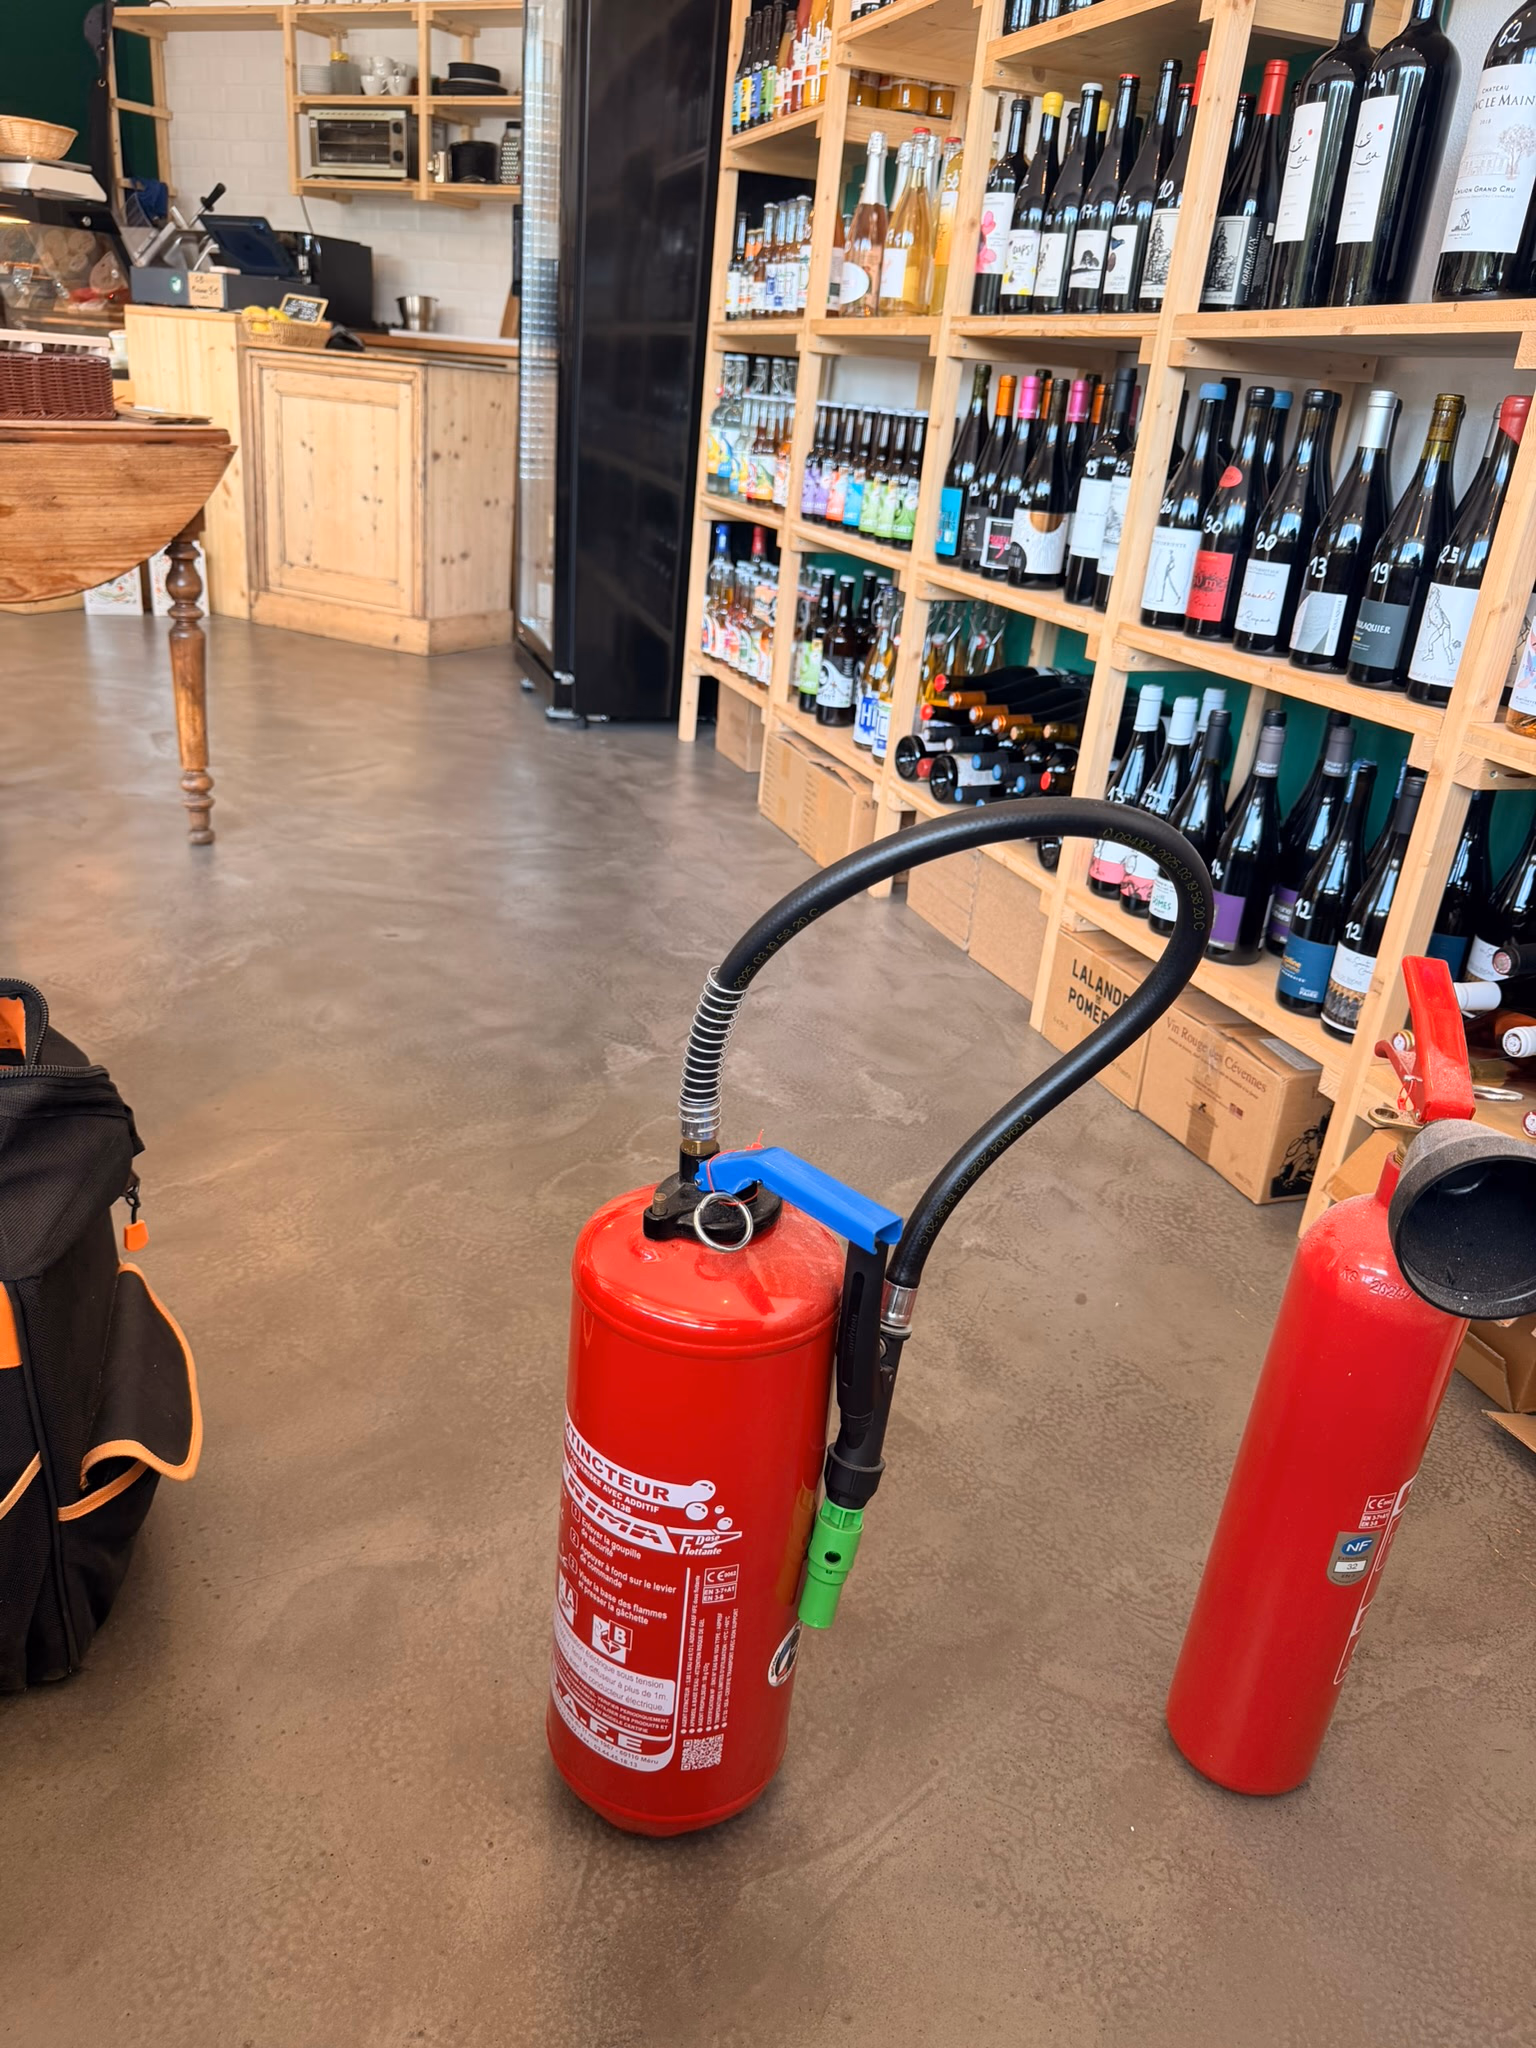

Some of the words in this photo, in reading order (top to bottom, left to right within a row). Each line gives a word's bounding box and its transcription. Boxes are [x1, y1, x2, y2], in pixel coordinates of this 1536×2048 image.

[1498, 22, 1522, 47] 62
[1481, 85, 1510, 94] CHATEAU
[1498, 94, 1536, 106] MAIN
[1474, 185, 1498, 193] GRAND
[1499, 185, 1517, 193] CRU
[1240, 236, 1257, 286] BORDEAUX
[1160, 498, 1175, 514] 26
[1204, 515, 1224, 535] 30
[1255, 531, 1278, 551] 20
[1439, 545, 1460, 565] 25
[1310, 556, 1328, 579] 13
[1370, 562, 1390, 584] 19
[1154, 849, 1182, 869] 2025
[1177, 867, 1192, 880] 03
[1193, 907, 1206, 920] 20
[1295, 898, 1312, 920] 12
[1193, 921, 1206, 931] C
[1345, 921, 1362, 941] 12
[733, 965, 756, 988] 2025
[753, 952, 768, 965] 03
[766, 941, 779, 951] 19
[776, 928, 793, 940] 58
[792, 917, 809, 929] 20
[809, 908, 820, 917] C
[1166, 1016, 1180, 1035] Vin
[1180, 1027, 1208, 1054] Rouge
[1224, 1056, 1267, 1093] Cévennes
[990, 1123, 1024, 1153] 094104
[967, 1152, 991, 1177] 2025
[954, 1176, 969, 1192] 03
[935, 1205, 949, 1218] 58
[925, 1219, 938, 1234] 20
[919, 1235, 929, 1246] C
[565, 1470, 663, 1545] RIMA
[602, 1484, 623, 1500] AVEC
[624, 1497, 660, 1514] ADDITIF
[611, 1499, 632, 1514] 113B
[589, 1534, 614, 1557] sécurité
[604, 1535, 611, 1546] la
[611, 1541, 642, 1560] goupille
[679, 1536, 723, 1556] Flottante
[695, 1535, 720, 1546] Dose
[1346, 1540, 1373, 1552] NF
[587, 1562, 623, 1588] commande
[605, 1562, 610, 1572] à
[610, 1566, 628, 1581] fond
[629, 1577, 642, 1586] sur
[644, 1580, 652, 1589] le
[653, 1582, 677, 1594] levier
[593, 1583, 599, 1592] la
[600, 1587, 617, 1603] base
[618, 1597, 632, 1610] des
[633, 1603, 668, 1620] flammes
[608, 1603, 615, 1612] la
[615, 1606, 649, 1626] gâchette
[614, 1626, 627, 1646] B
[616, 1669, 634, 1683] sous
[635, 1676, 664, 1689] tension
[617, 1679, 623, 1689] à
[623, 1683, 640, 1699] plus
[641, 1688, 652, 1699] de
[654, 1691, 669, 1701] 1m.
[625, 1694, 665, 1715] électrique.
[630, 1717, 660, 1730] PRODUITS
[619, 1749, 640, 1761] 60110
[640, 1756, 659, 1766] Méru
